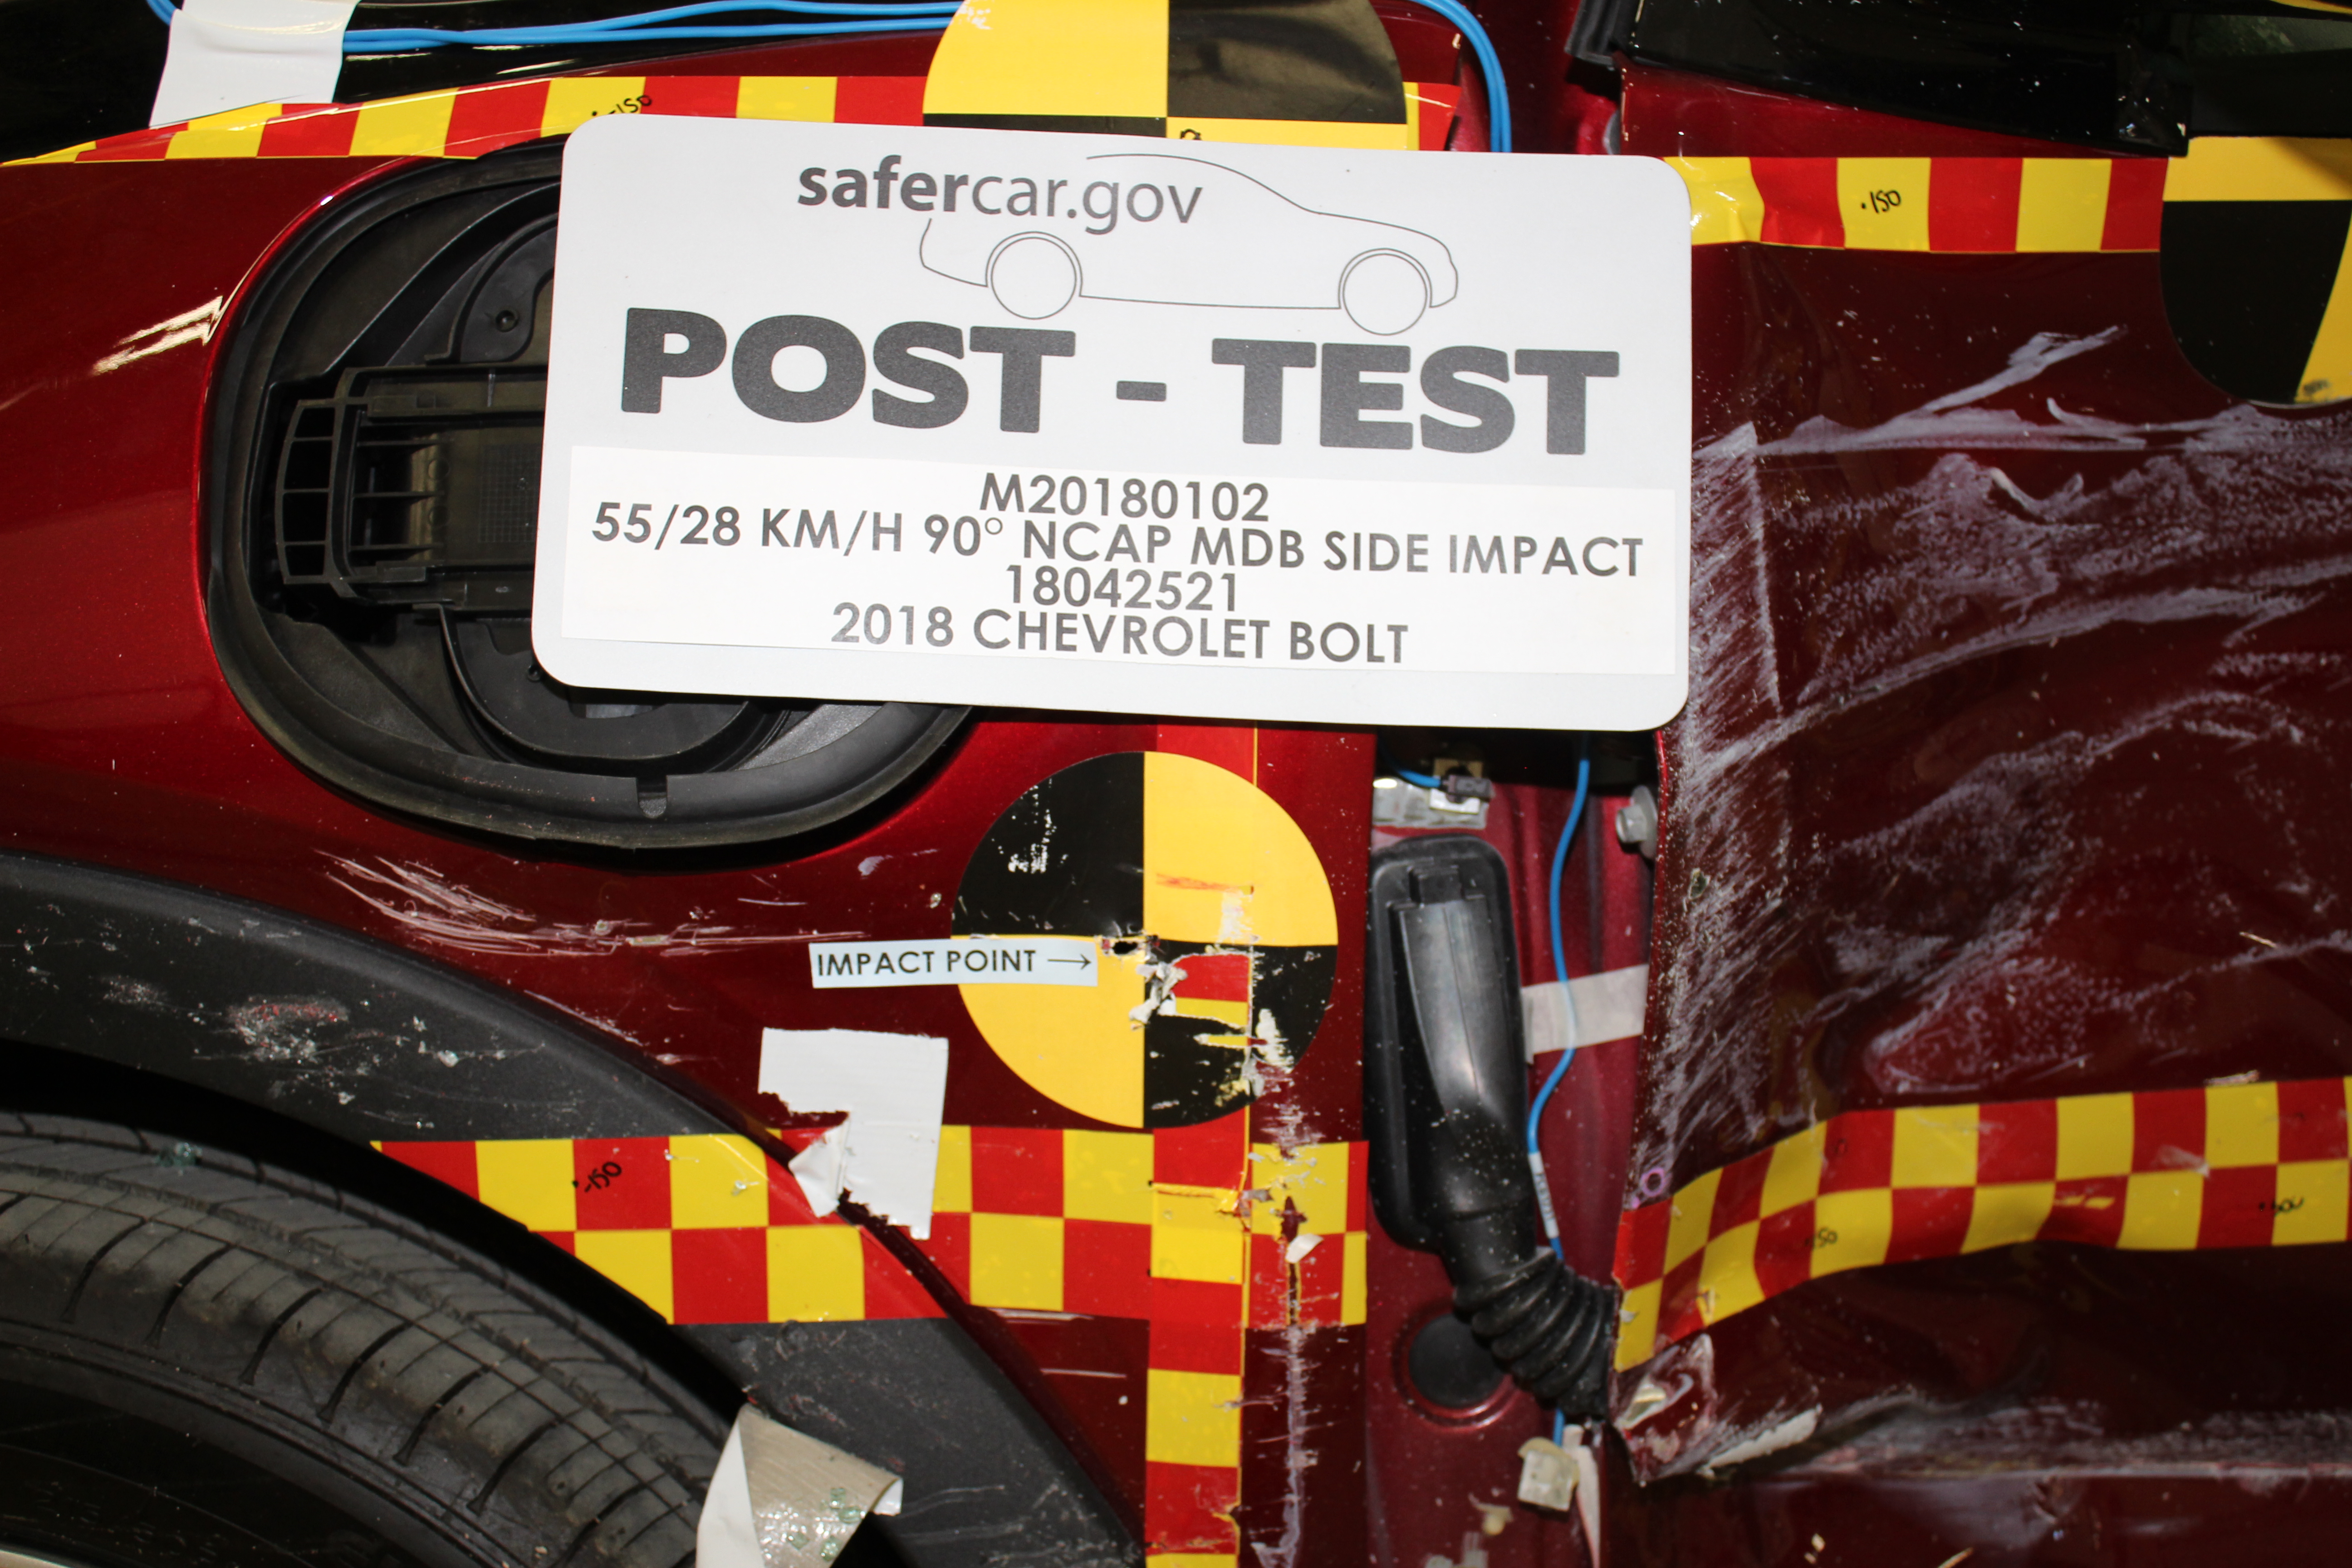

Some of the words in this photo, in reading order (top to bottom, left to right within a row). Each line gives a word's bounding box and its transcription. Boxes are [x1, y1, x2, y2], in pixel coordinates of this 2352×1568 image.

[798, 155, 1203, 235] safercar.gov
[621, 307, 1076, 433] POST
[1116, 380, 1167, 402] -
[1212, 338, 1619, 455] TEST
[980, 473, 1268, 522] M20180102
[592, 502, 740, 550] 55/28
[762, 508, 902, 556] KM/H
[924, 514, 1003, 556] 90°
[1024, 520, 1171, 563] NCAP
[1191, 527, 1304, 568] MDB
[1324, 531, 1428, 572] SIDE
[1450, 535, 1643, 577] IMPACT
[1007, 565, 1235, 612] 18042521
[832, 602, 953, 647] 2018
[974, 609, 1270, 658] CHEVROLET
[1290, 621, 1408, 663] BOLT
[818, 951, 934, 976] IMPACT
[947, 950, 1036, 972] POINT
